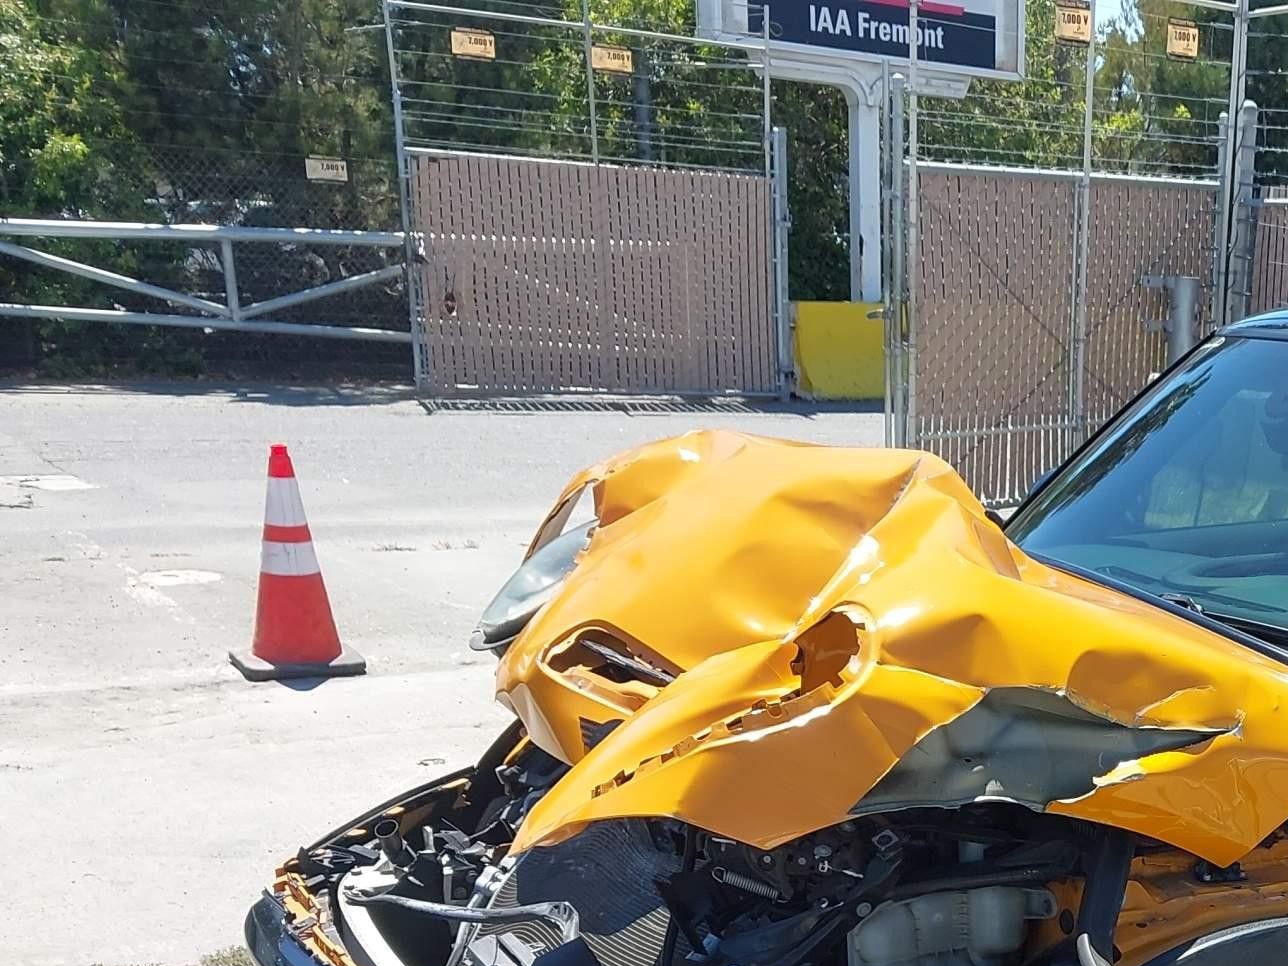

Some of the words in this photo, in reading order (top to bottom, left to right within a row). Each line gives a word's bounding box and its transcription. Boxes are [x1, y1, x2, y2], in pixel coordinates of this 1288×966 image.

[1062, 12, 1082, 25] 7,000
[1083, 14, 1089, 26] V
[809, 4, 852, 36] IAA
[858, 11, 944, 49] Fremont
[468, 36, 488, 47] 7,000
[488, 39, 493, 48] V
[1192, 33, 1197, 43] V
[607, 52, 625, 62] 7,000
